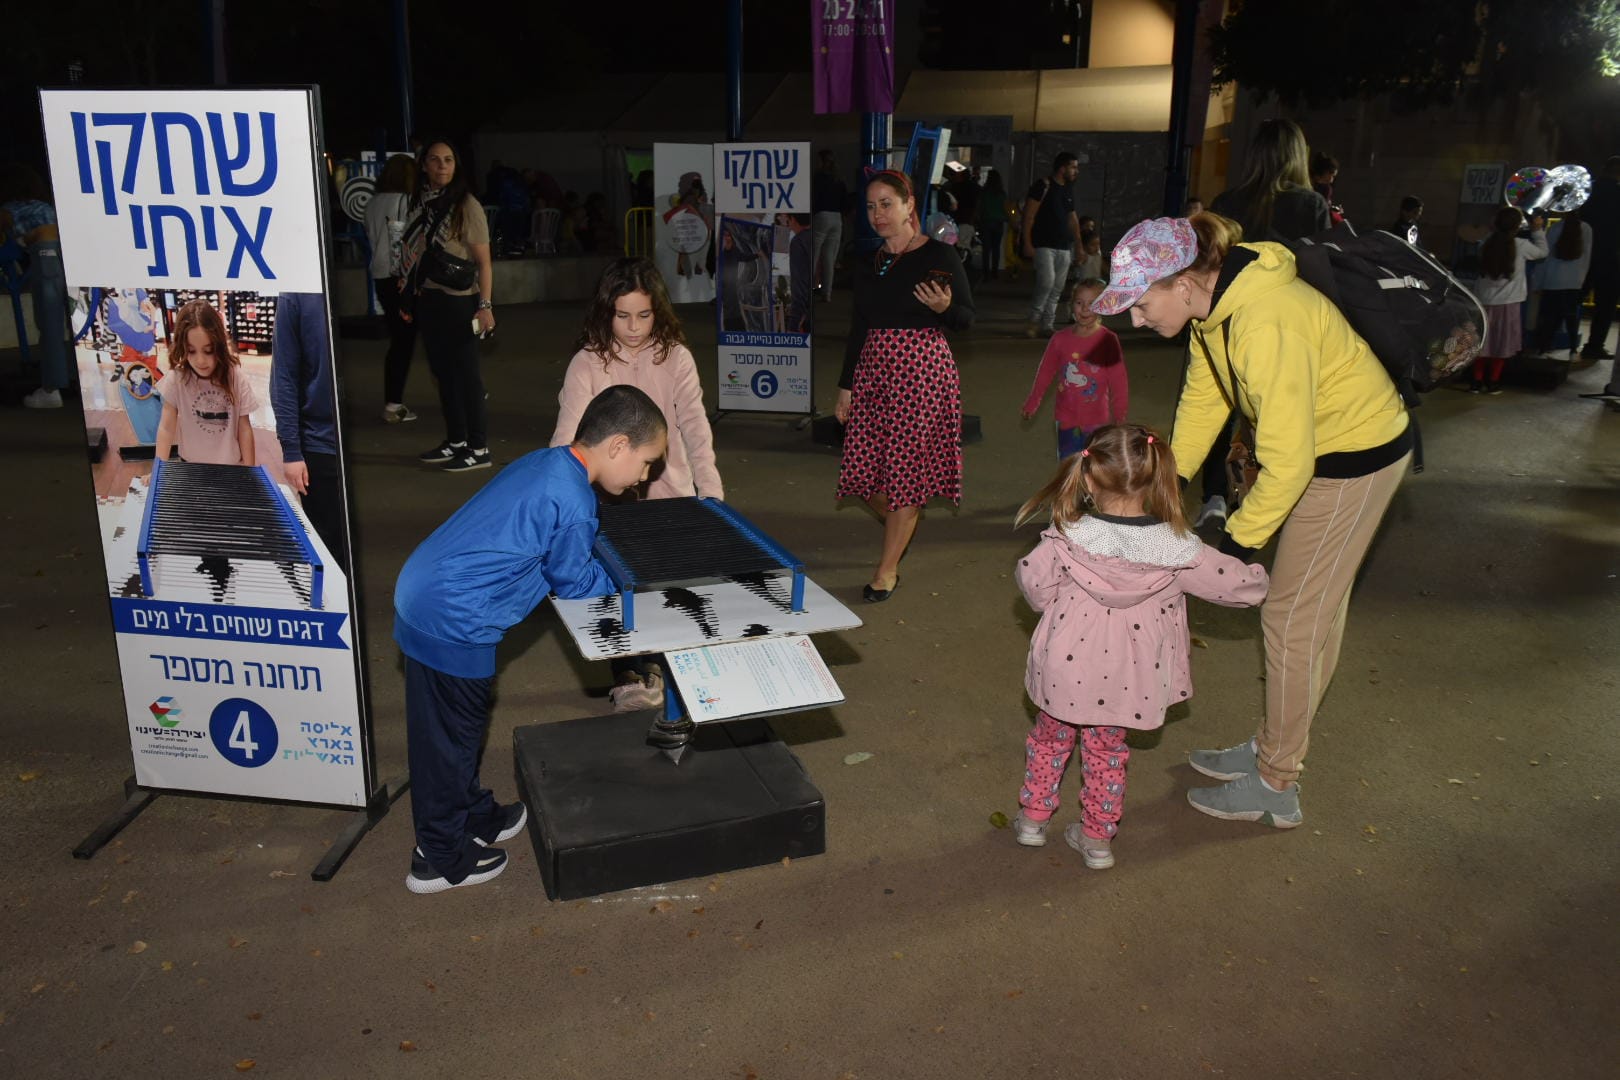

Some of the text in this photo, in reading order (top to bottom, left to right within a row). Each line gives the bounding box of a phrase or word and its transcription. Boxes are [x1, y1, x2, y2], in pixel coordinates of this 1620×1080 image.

[70, 111, 278, 215] שחקו
[724, 149, 799, 187] שחקו
[741, 182, 795, 209] איתי
[130, 204, 277, 279] איתי
[726, 334, 803, 345] פתאום נהייתי גבוה
[730, 353, 798, 366] תחנה מספר
[757, 374, 772, 396] 6
[132, 606, 325, 641] דגים שוחים בלי מים
[149, 653, 322, 692] תחנה מספר
[228, 710, 259, 759] 4
[300, 721, 352, 737] אליסה
[282, 748, 355, 766] האשליות
[308, 737, 354, 751] בארץ
